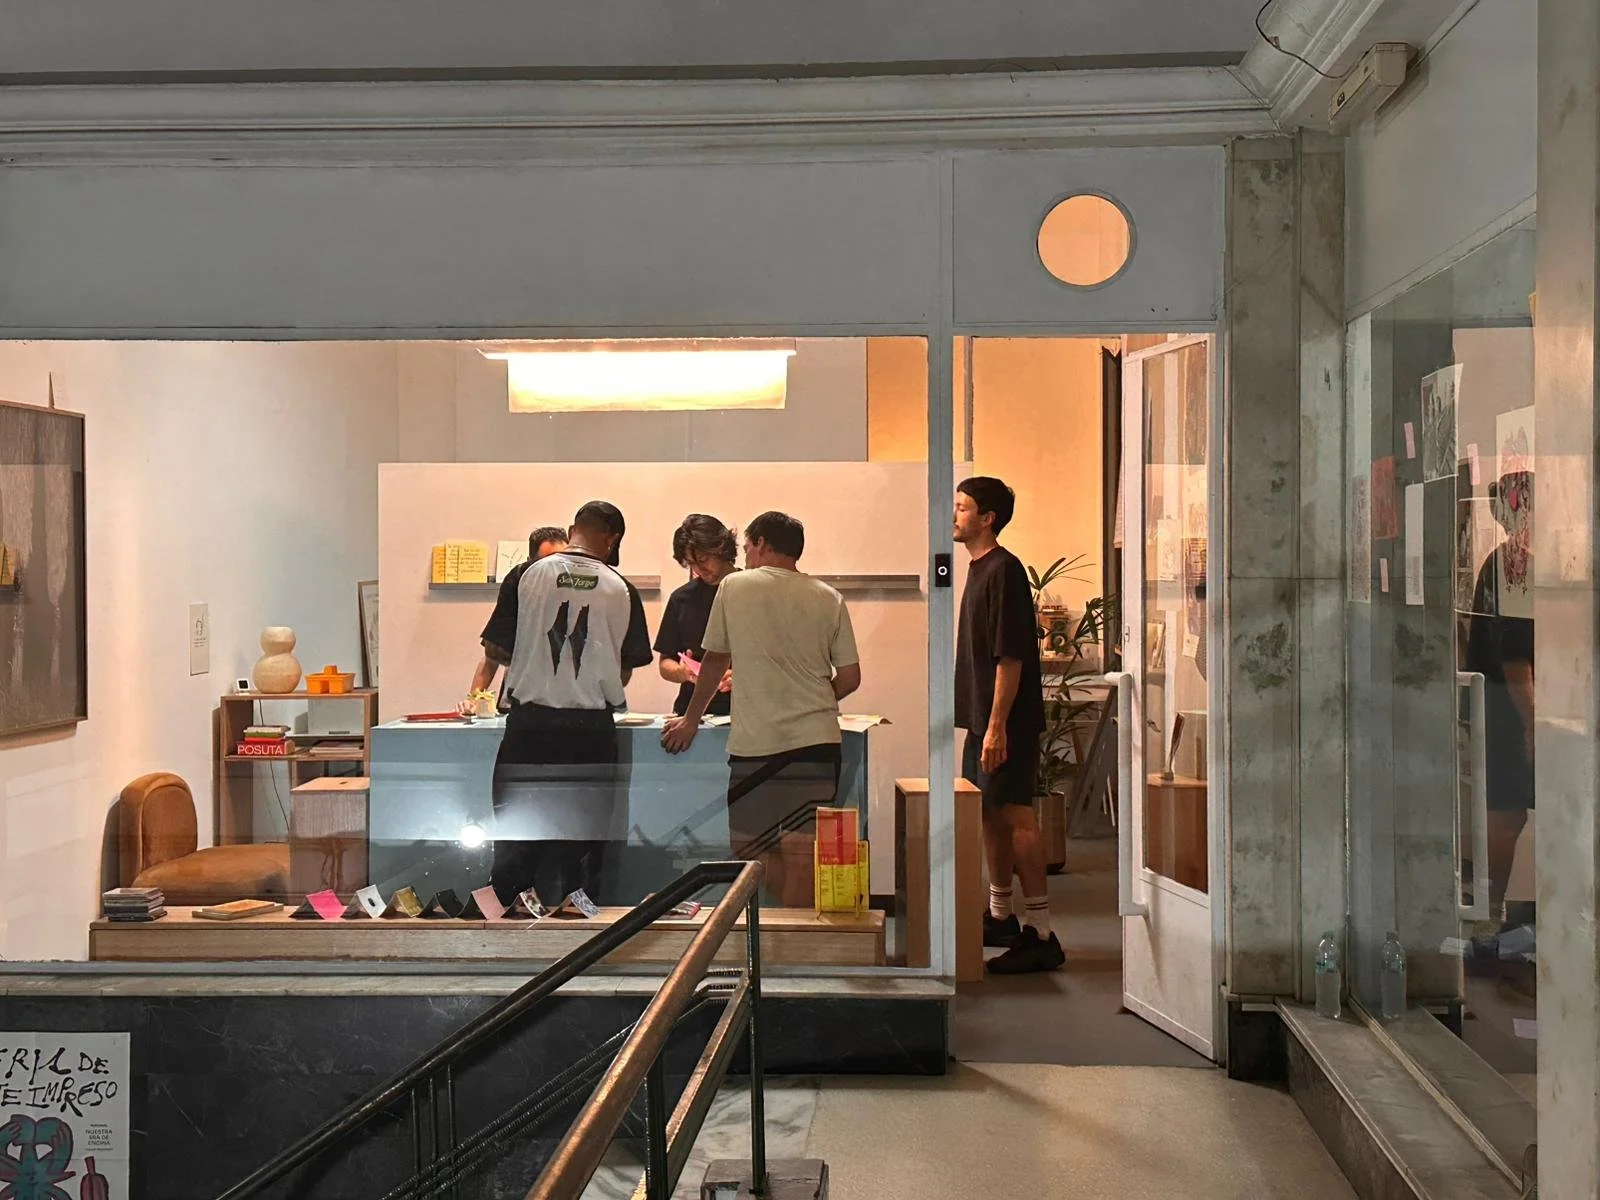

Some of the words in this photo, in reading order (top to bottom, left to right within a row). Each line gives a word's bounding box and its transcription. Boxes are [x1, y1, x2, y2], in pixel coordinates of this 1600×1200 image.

[237, 744, 283, 755] POSUTA
[78, 1052, 109, 1074] DE
[26, 1076, 118, 1117] IMPRESO
